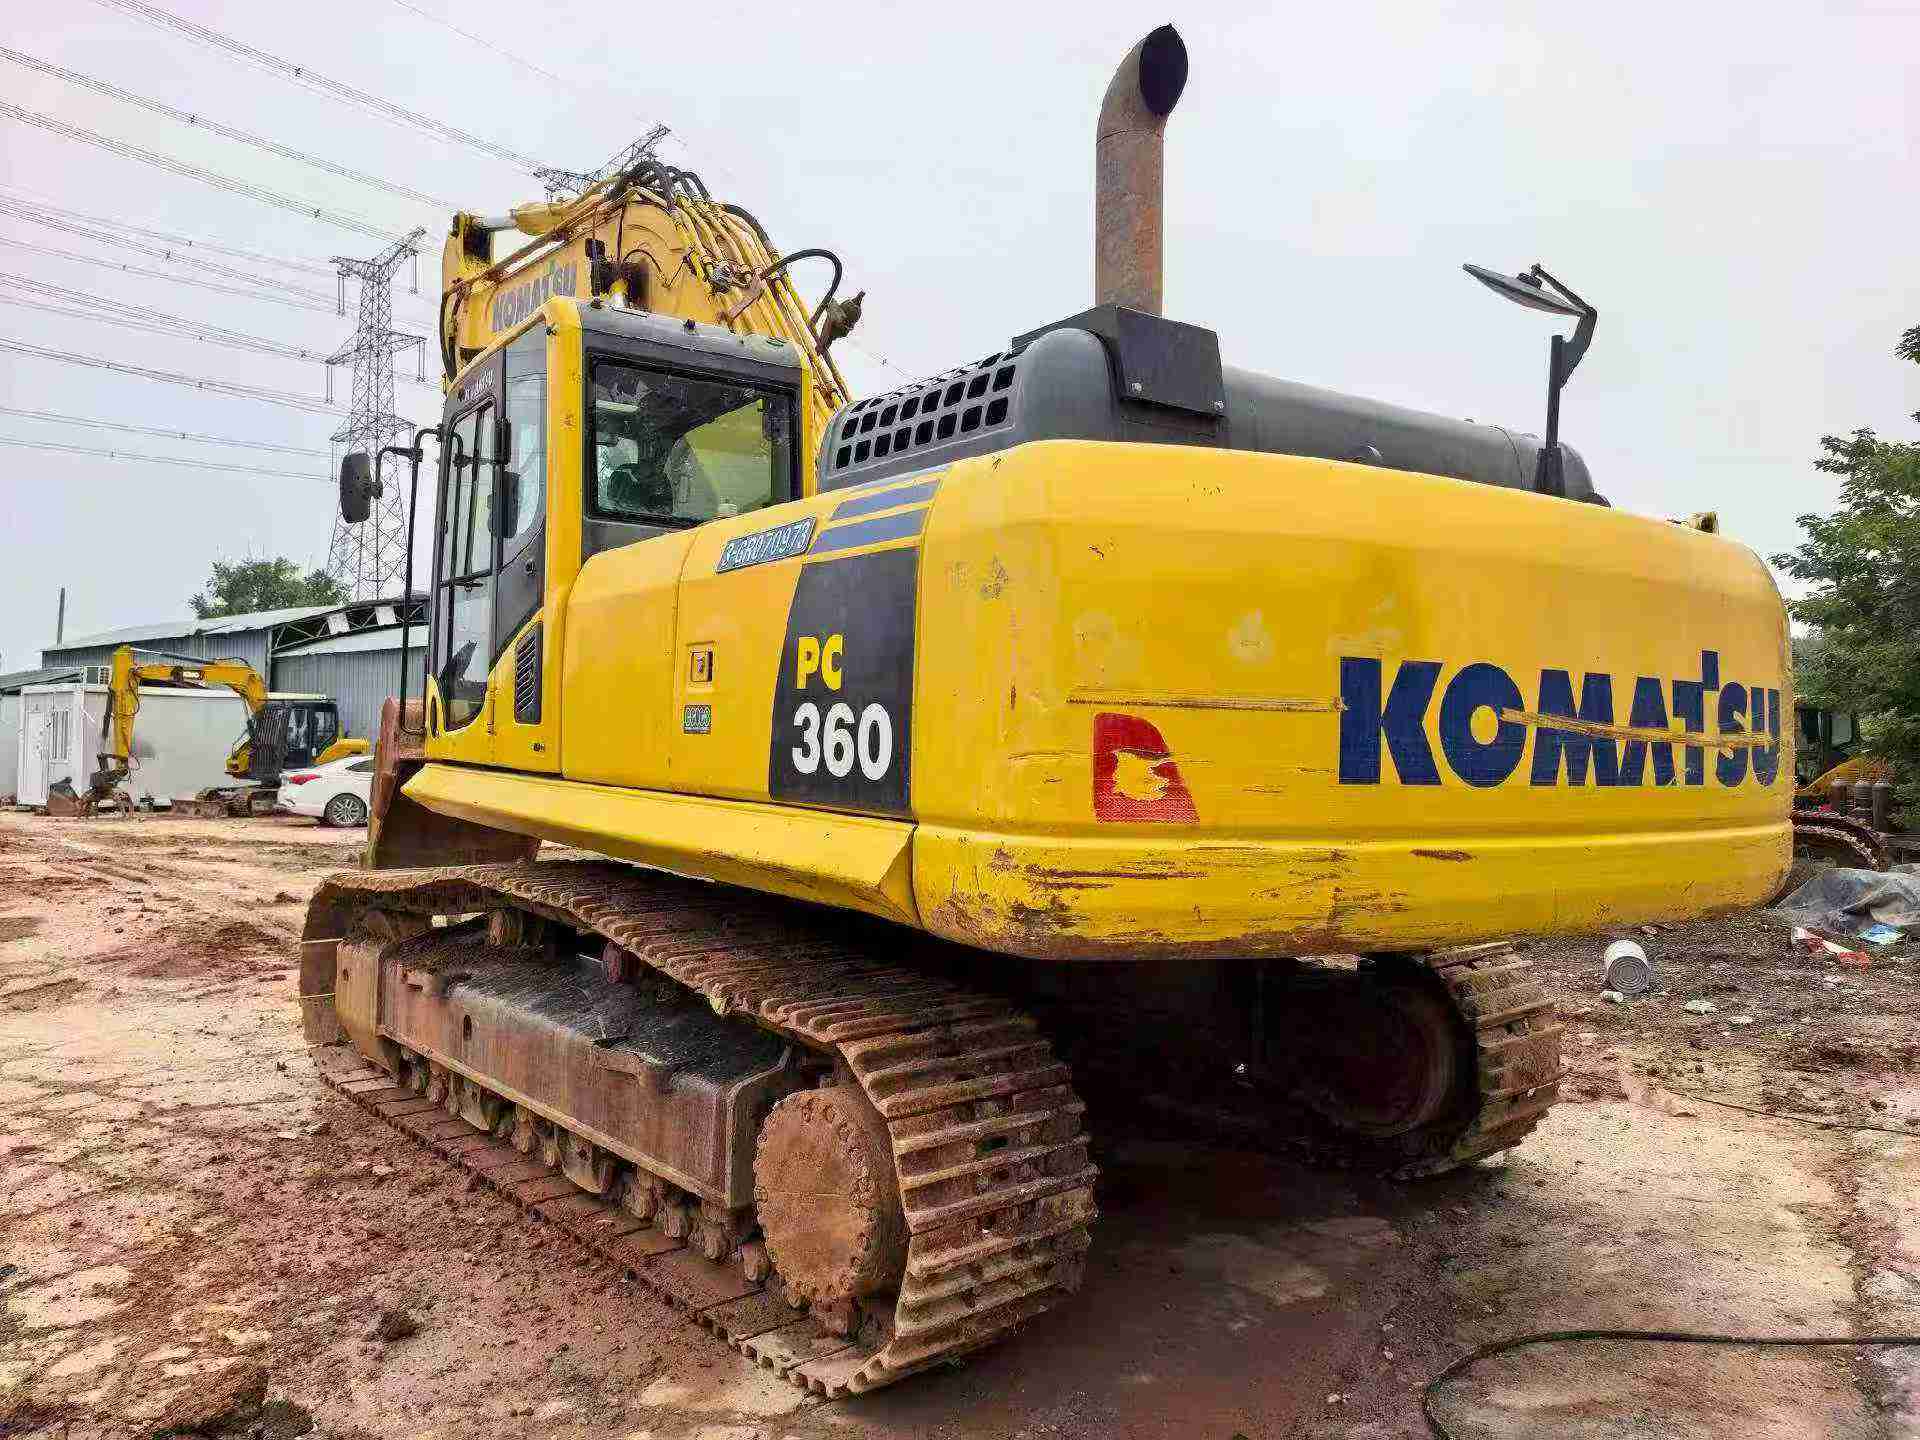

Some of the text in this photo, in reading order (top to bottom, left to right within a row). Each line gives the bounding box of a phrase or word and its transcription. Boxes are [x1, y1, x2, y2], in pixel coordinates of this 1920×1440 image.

[796, 634, 844, 691] PC
[791, 702, 893, 781] 360
[1338, 650, 1781, 789] KOMATSU
